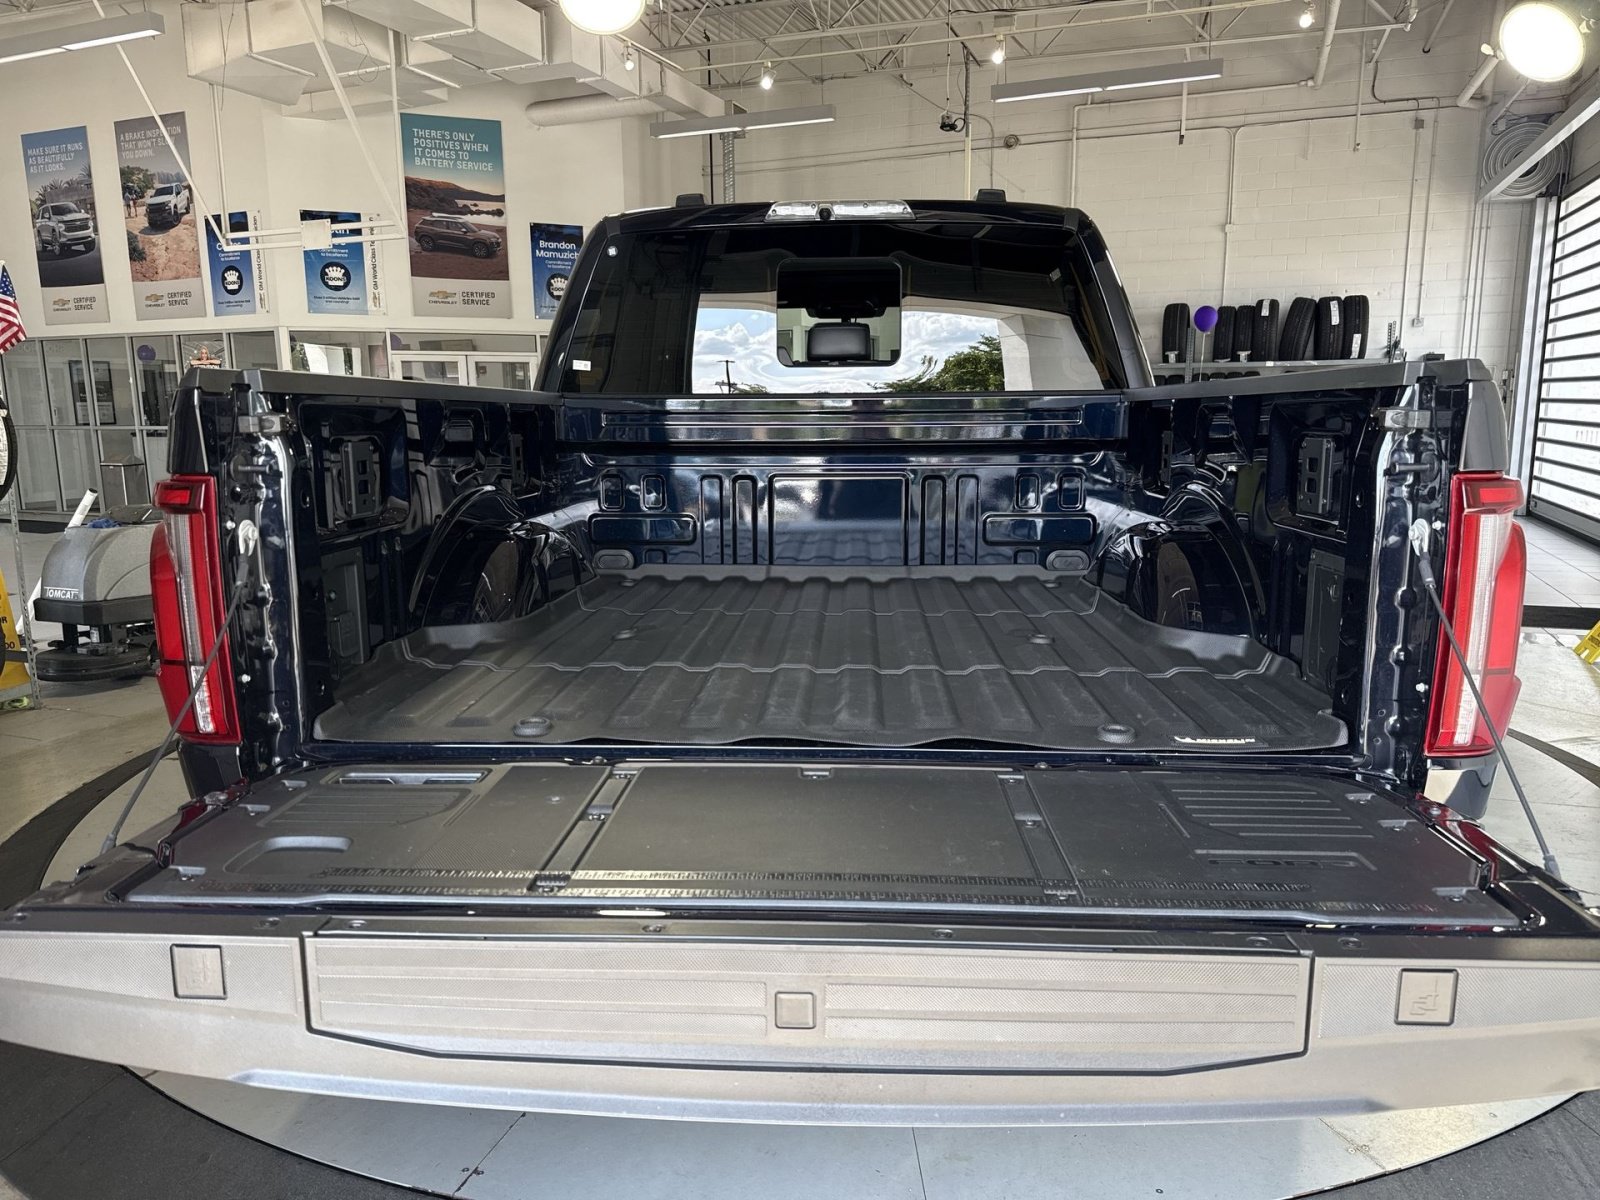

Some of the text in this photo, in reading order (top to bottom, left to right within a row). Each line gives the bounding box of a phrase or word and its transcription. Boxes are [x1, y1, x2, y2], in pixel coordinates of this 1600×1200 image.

[120, 125, 181, 142] A BRAKE INSPETION
[412, 128, 475, 142] THERE'S ONLY
[27, 142, 83, 157] MAKE SURE IT RUNS
[121, 141, 136, 150] THAT
[137, 139, 156, 149] WON'T
[413, 138, 489, 152] POSITIVES WHEN
[29, 152, 75, 165] AS BEAUTIFULLY
[122, 150, 133, 159] YOU
[414, 147, 469, 160] IT COMES TO
[30, 163, 66, 173] AS IT LOOKS.
[414, 157, 494, 171] BATTERY SERVICE
[539, 240, 576, 250] Brandon
[73, 296, 97, 304] CERTIFIED
[167, 291, 193, 299] CERTIFIED
[461, 291, 496, 299] CERTIFIED
[74, 303, 94, 311] SERVICE
[168, 298, 189, 307] SERVICE
[462, 298, 491, 306] SERVICE
[43, 586, 79, 599] TOMCAT
